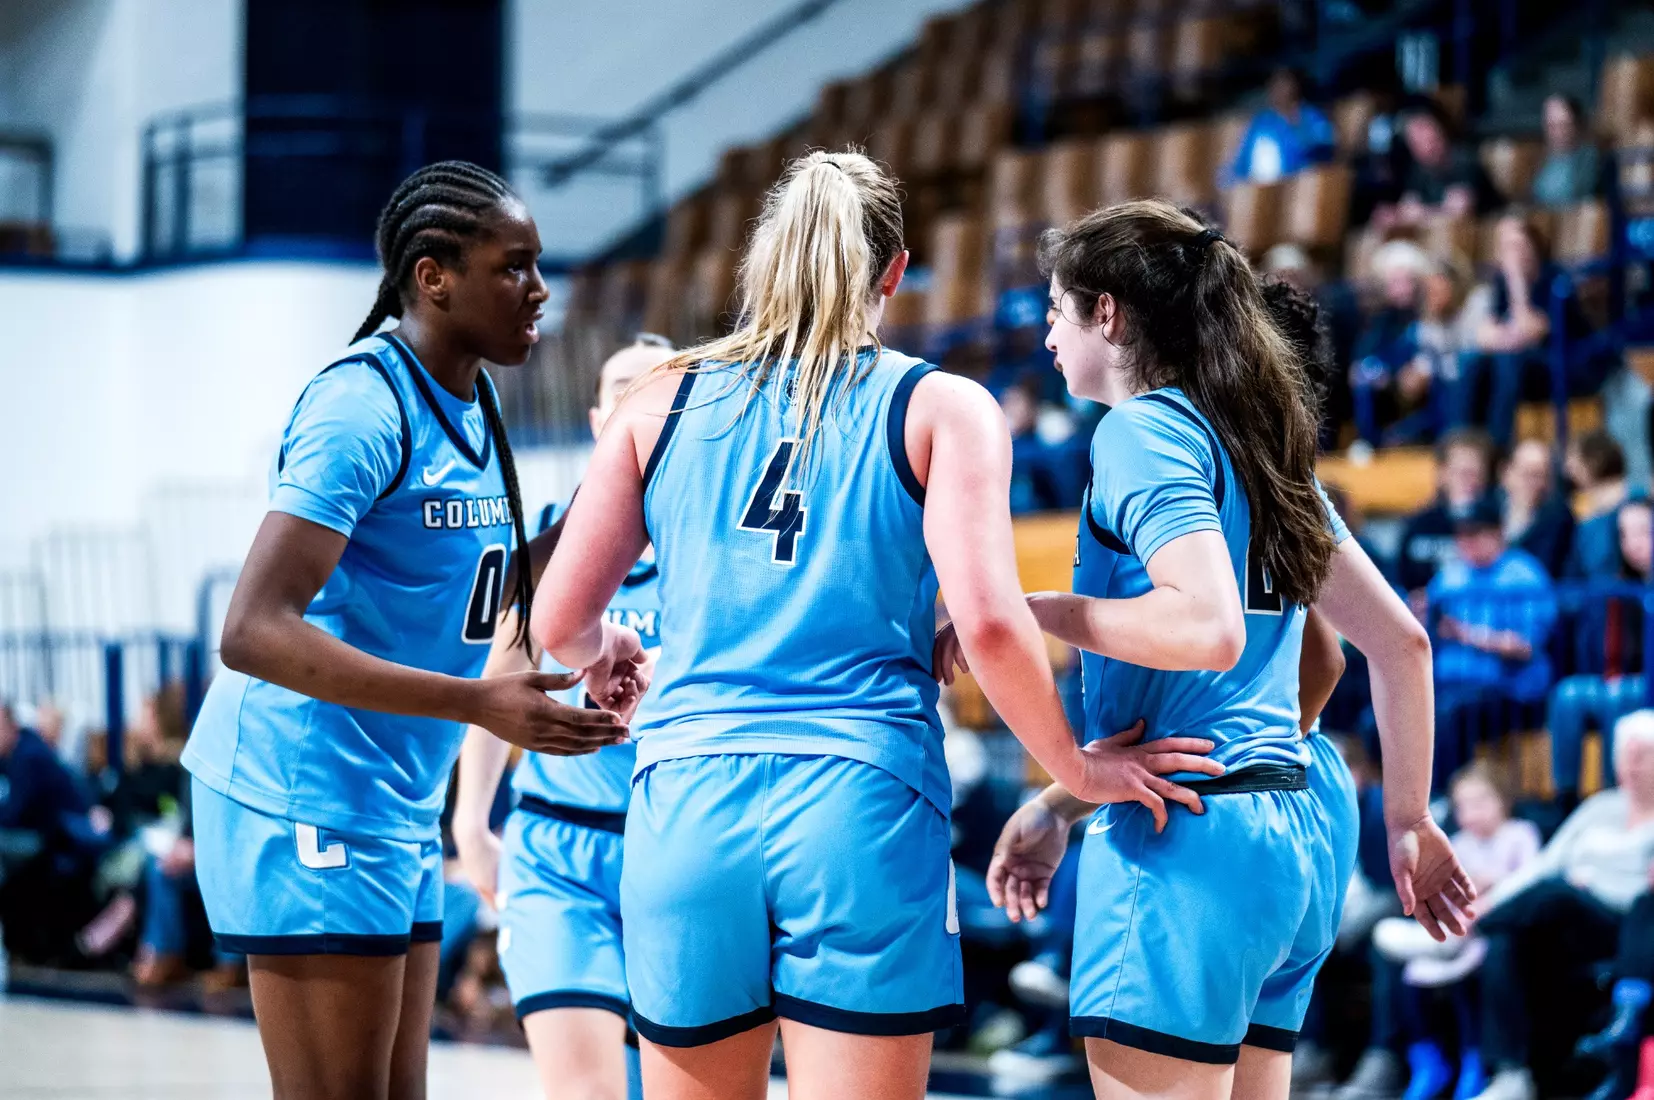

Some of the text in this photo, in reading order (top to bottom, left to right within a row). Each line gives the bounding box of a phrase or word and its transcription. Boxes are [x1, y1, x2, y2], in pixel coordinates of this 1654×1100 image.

[422, 496, 513, 530] COLUM
[736, 437, 808, 565] 4
[461, 542, 508, 645] 0
